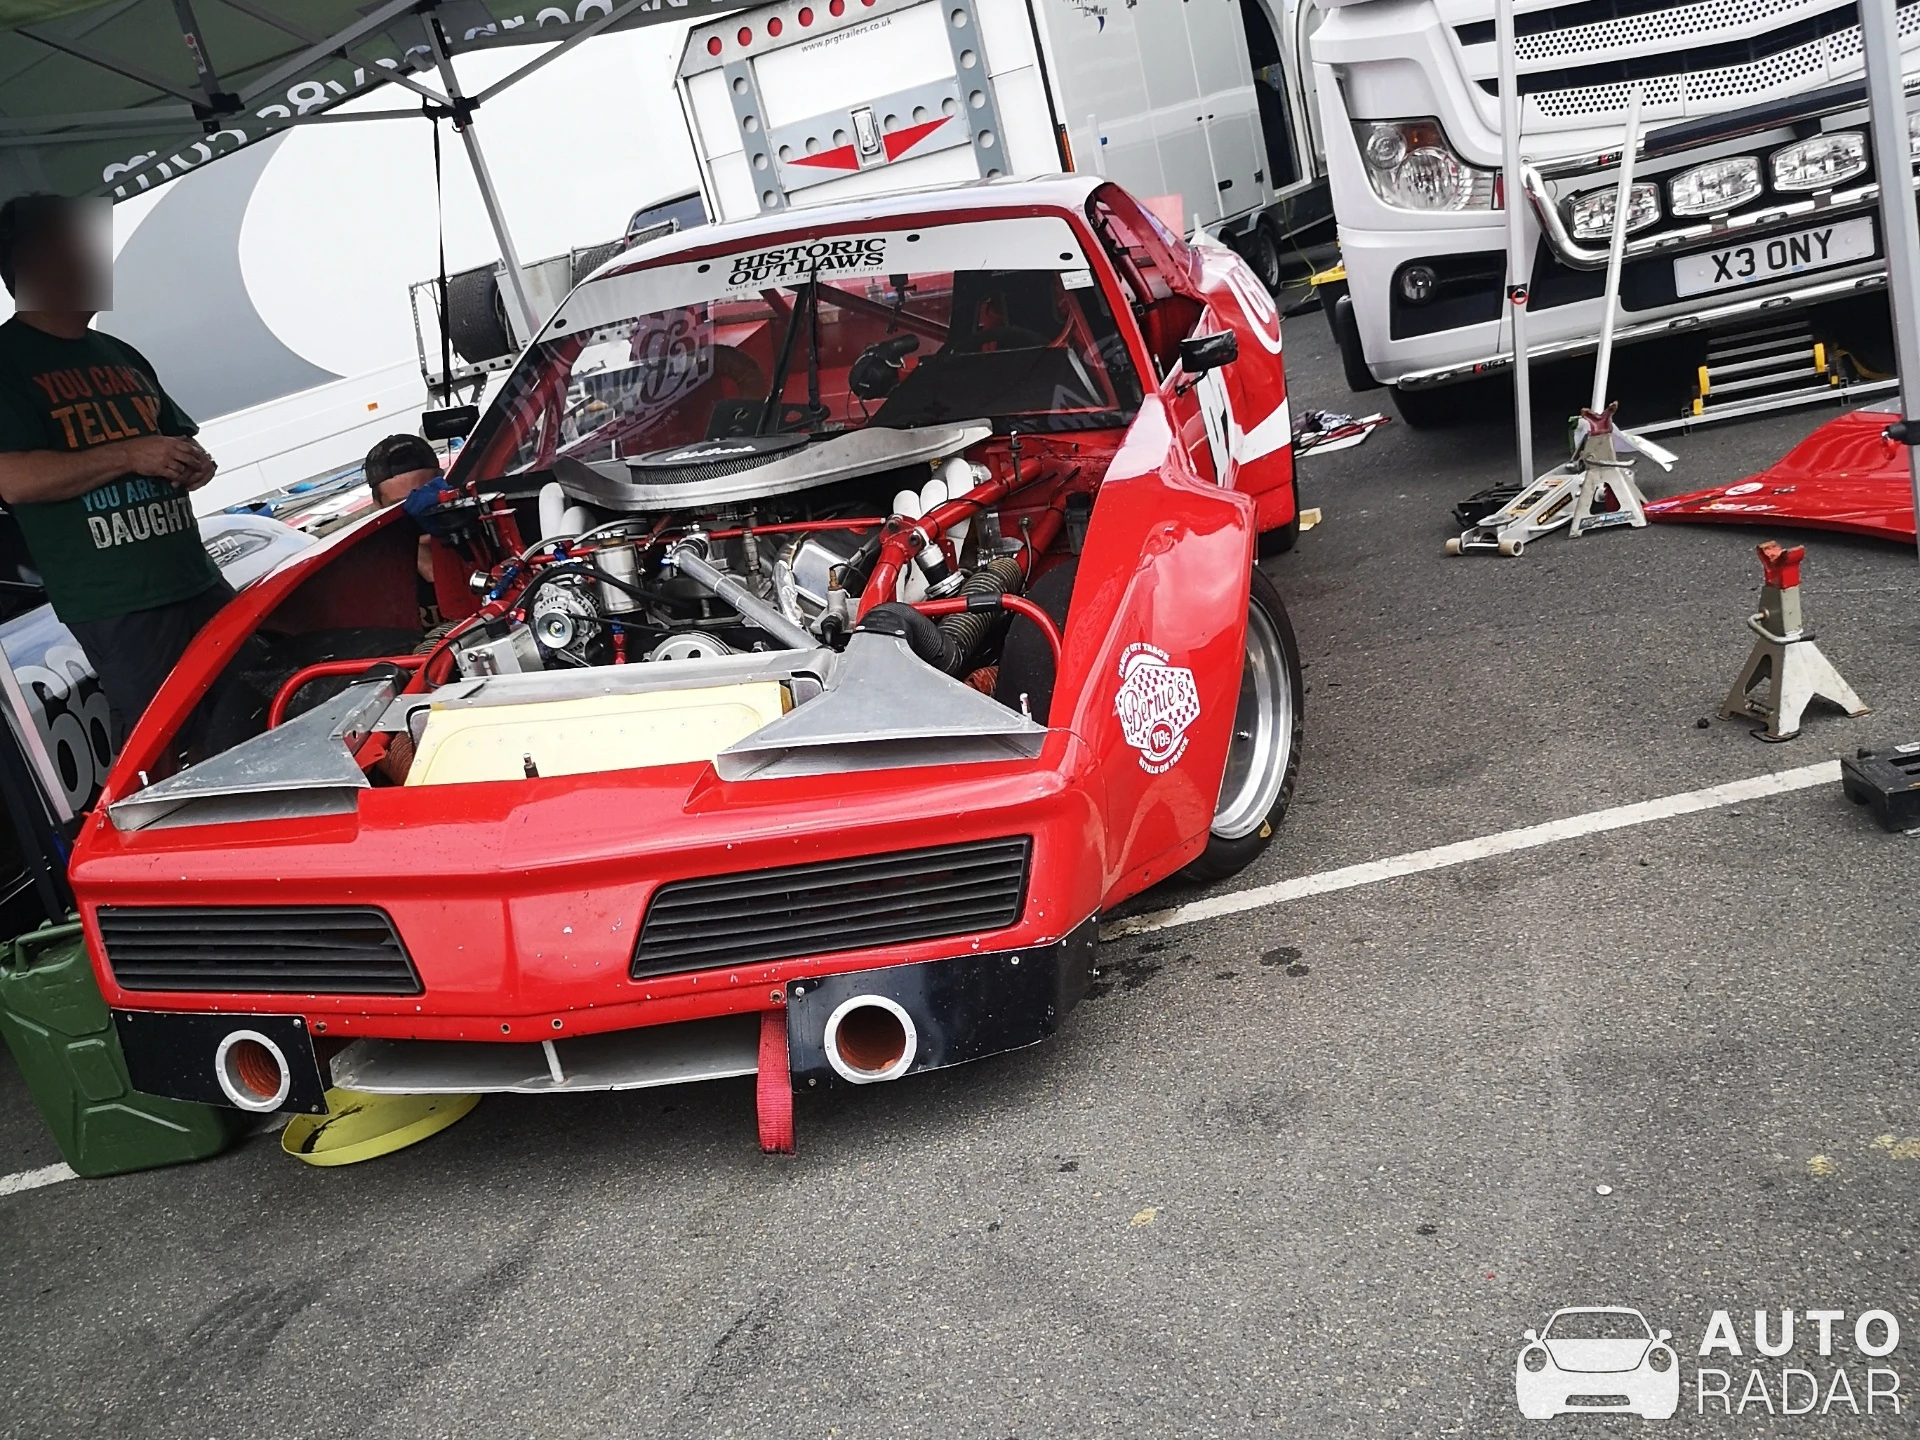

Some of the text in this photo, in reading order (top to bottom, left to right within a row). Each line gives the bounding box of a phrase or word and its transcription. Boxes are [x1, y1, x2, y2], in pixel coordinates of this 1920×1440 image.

[801, 17, 892, 52] www.prgtrailers.co.uk
[728, 252, 884, 285] OUTLAWS
[731, 238, 887, 273] HISTORIC
[1711, 248, 1756, 283] X3
[1767, 229, 1833, 270] ONY
[726, 281, 764, 292] WHERE
[836, 266, 883, 274] RETURN
[33, 369, 92, 403] YOU
[51, 401, 140, 448] TELL
[82, 486, 121, 512] YOU
[126, 479, 159, 504] ARE
[88, 496, 197, 549] DAUGHT
[1123, 678, 1186, 735] Bernie's
